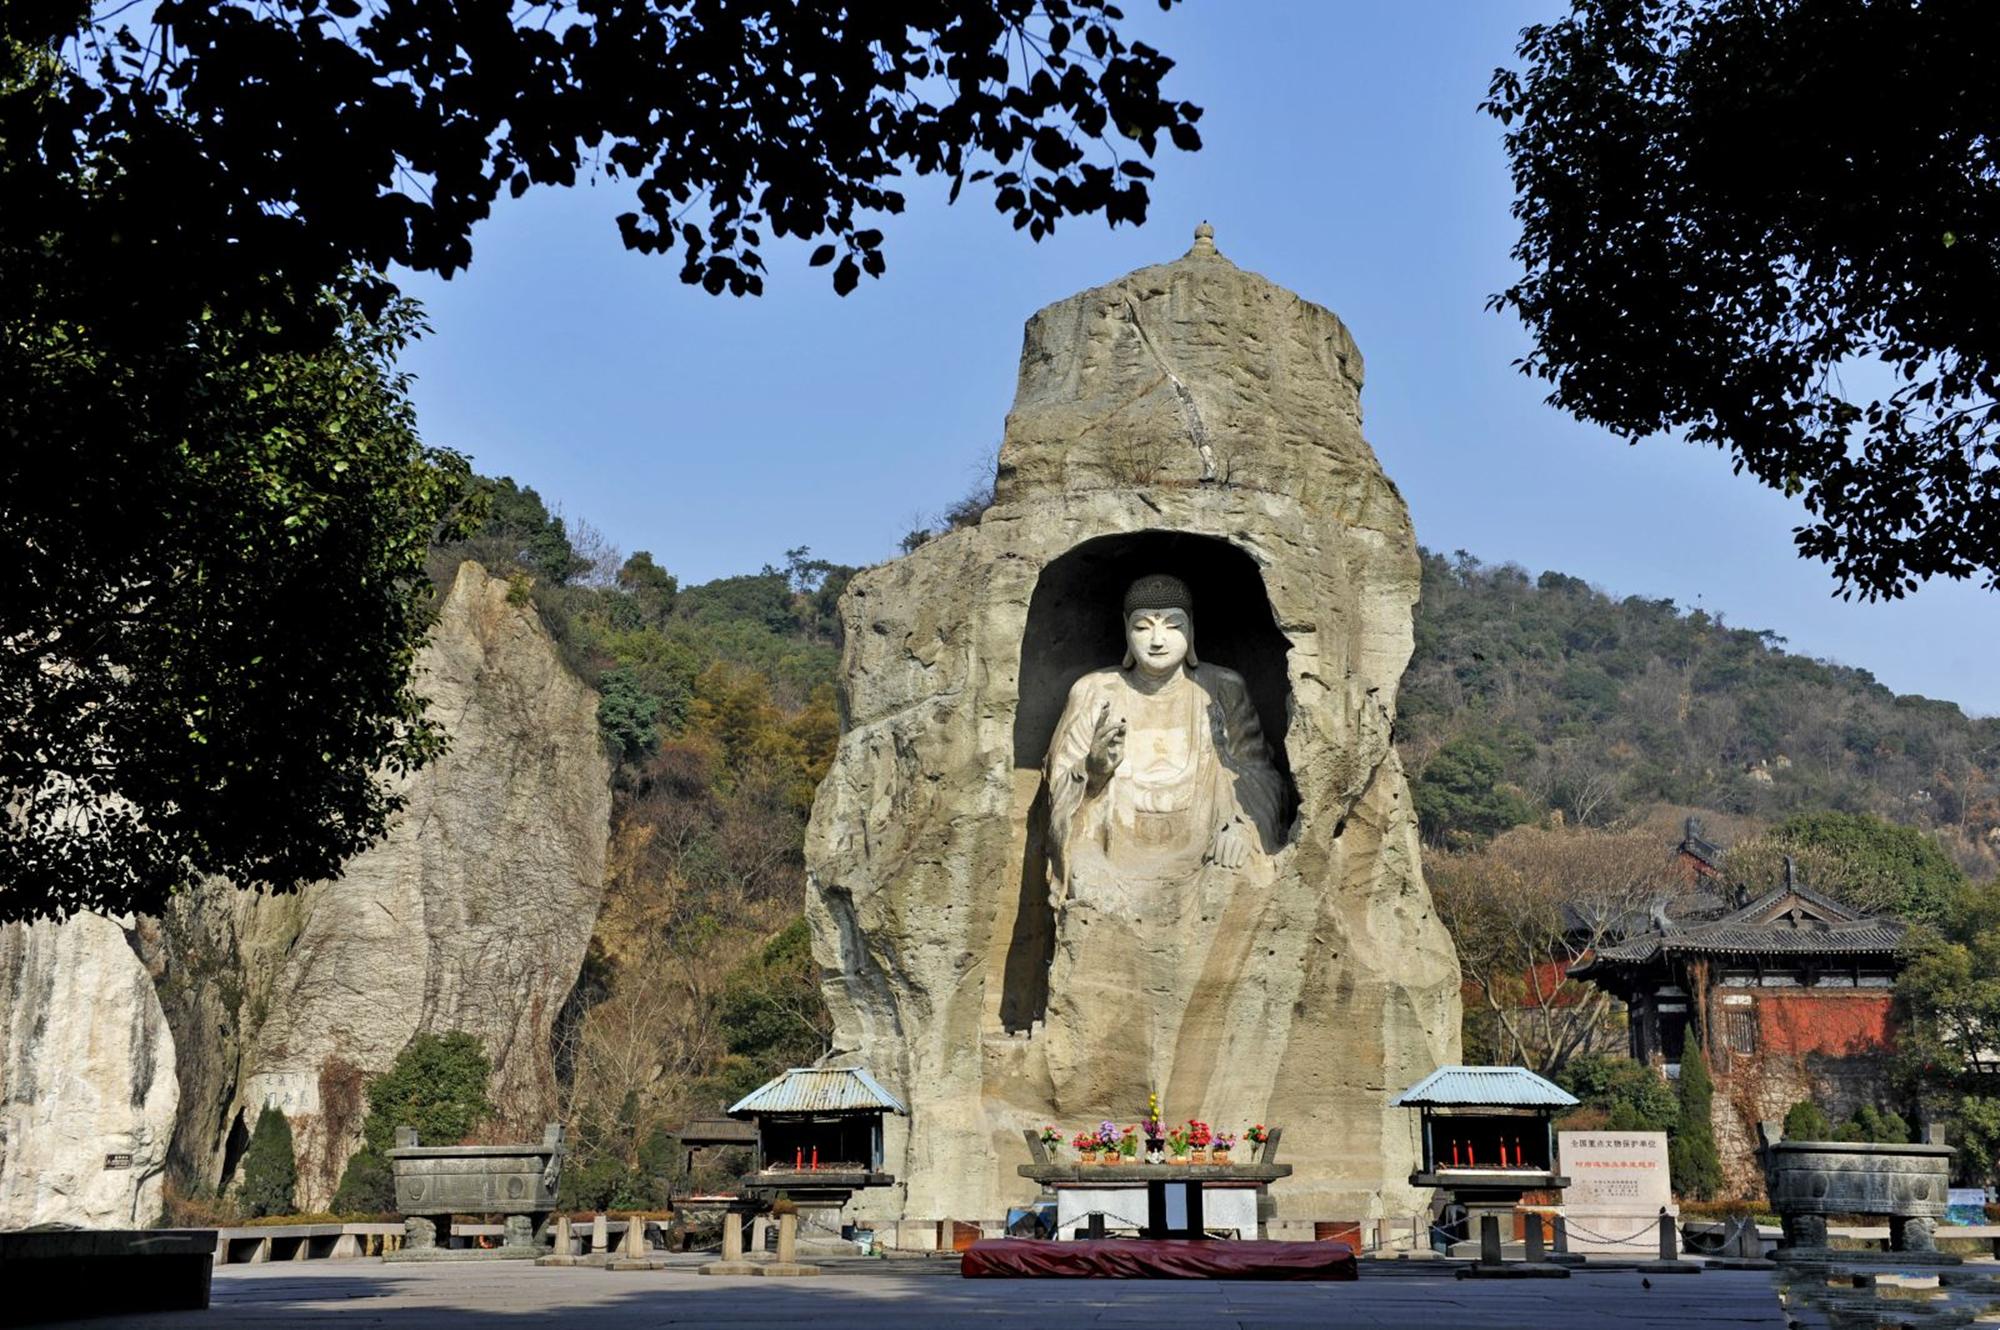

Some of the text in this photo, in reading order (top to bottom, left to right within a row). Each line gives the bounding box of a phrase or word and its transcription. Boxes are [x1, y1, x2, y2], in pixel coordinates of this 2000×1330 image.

[1571, 1139, 1656, 1148] 全国重点文物保护单位
